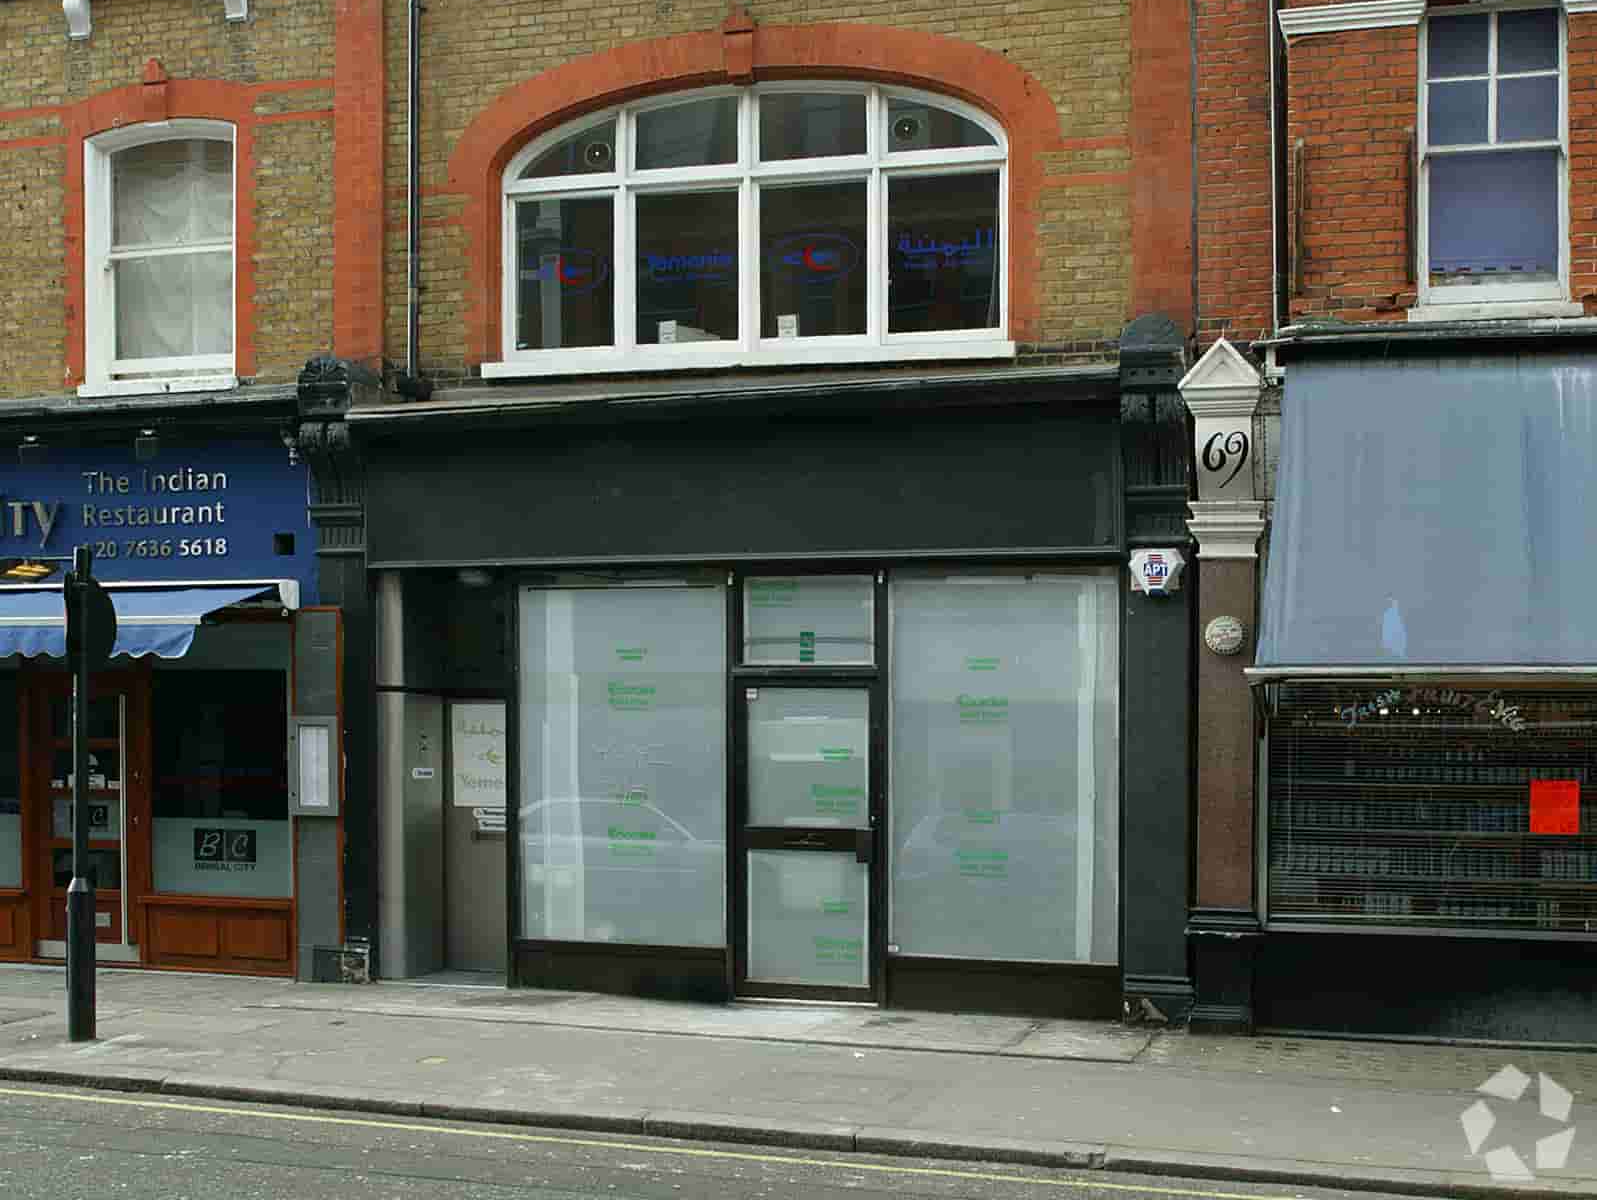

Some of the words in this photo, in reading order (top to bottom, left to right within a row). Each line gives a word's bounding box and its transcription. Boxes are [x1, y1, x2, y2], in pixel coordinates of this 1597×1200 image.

[1203, 431, 1249, 488] 69
[82, 471, 129, 494] The
[144, 467, 227, 493] Indian
[82, 501, 225, 527] Restaurant
[126, 539, 172, 558] 7636
[179, 538, 227, 556] 5618
